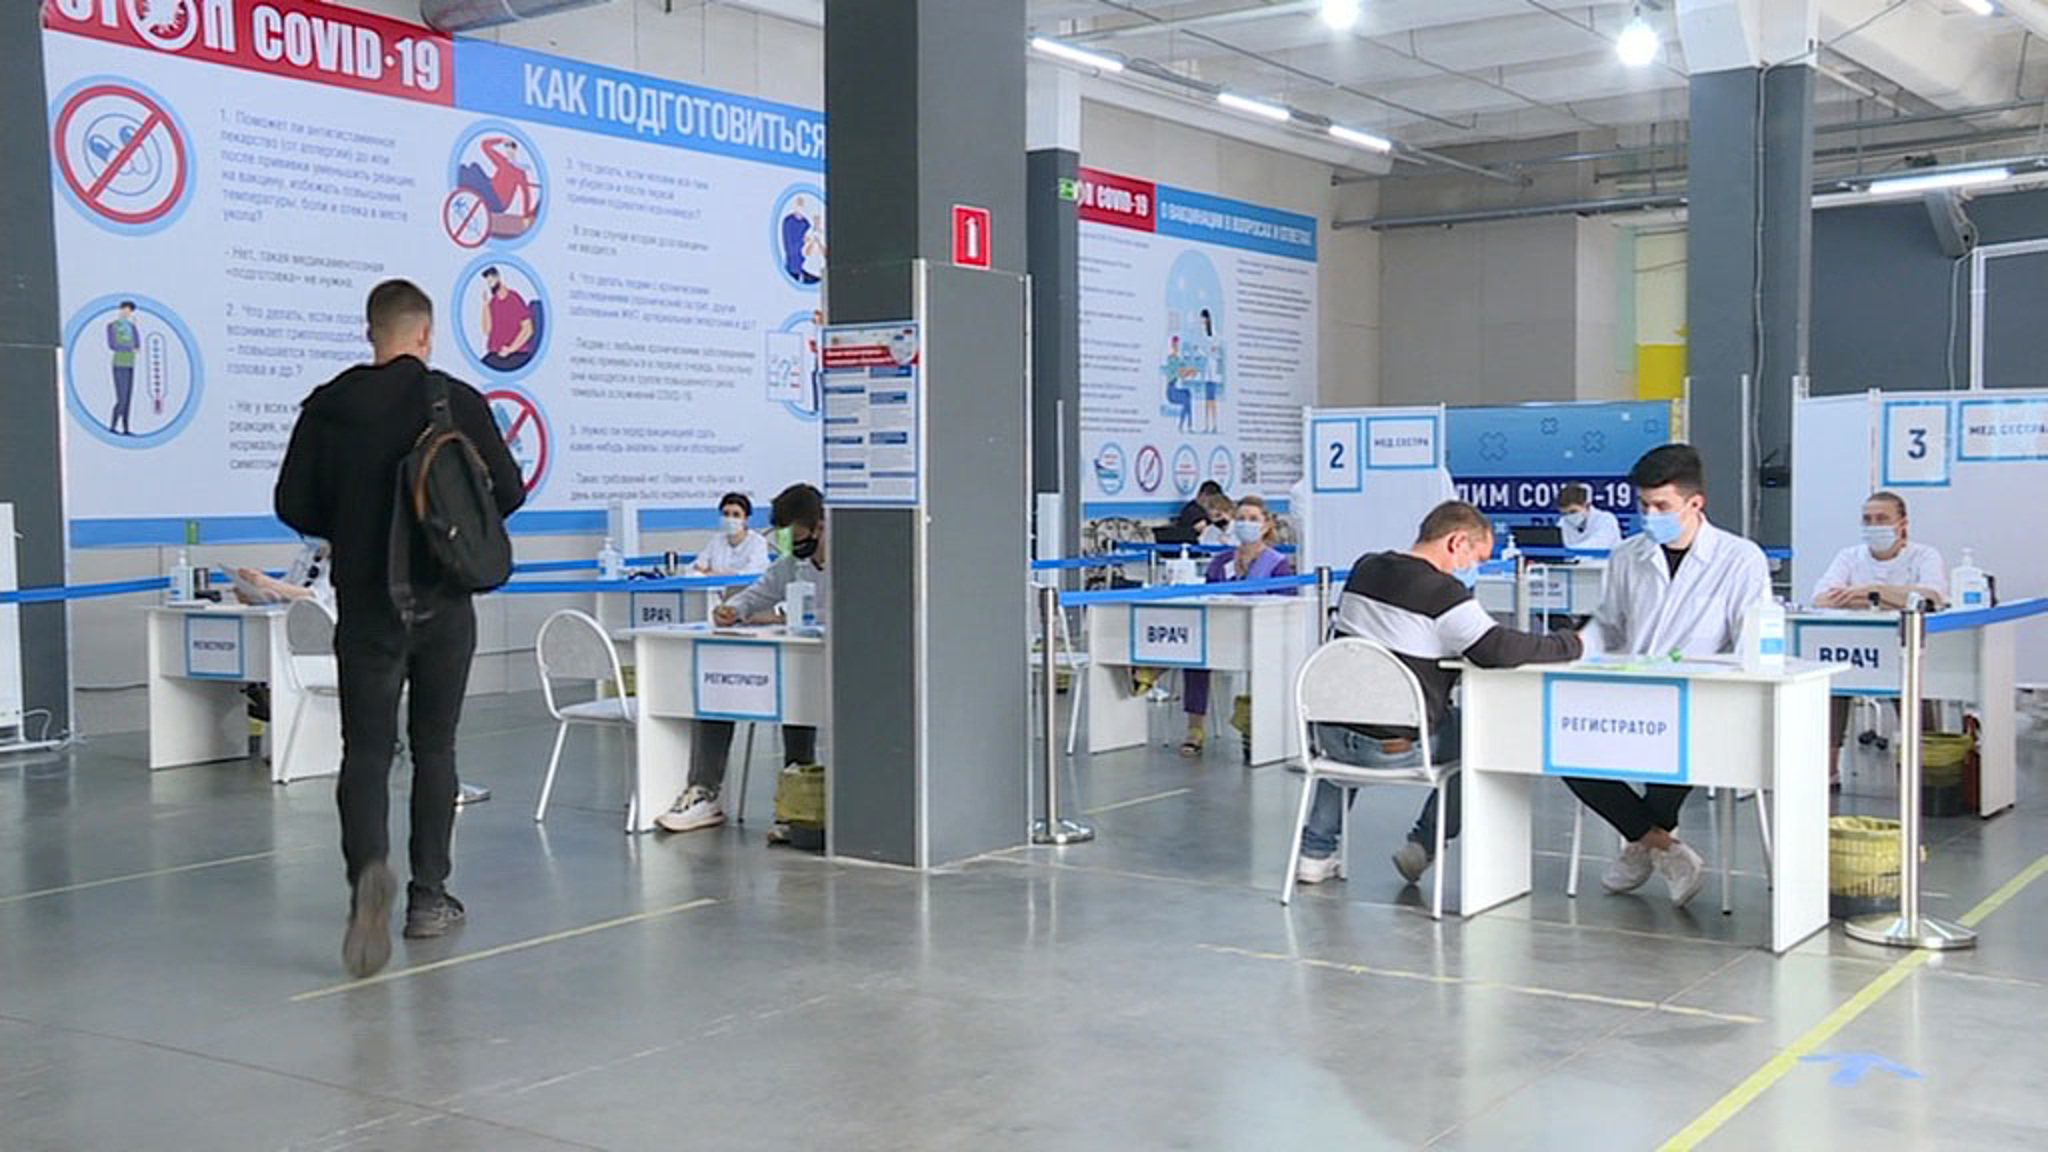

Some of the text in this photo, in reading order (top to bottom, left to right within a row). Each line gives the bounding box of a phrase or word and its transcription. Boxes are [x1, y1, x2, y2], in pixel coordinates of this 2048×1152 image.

[523, 63, 826, 161] КАК ПОДГОТОВИТЬСЯ
[1906, 428, 1928, 459] 3
[1329, 443, 1345, 468] 2
[1147, 625, 1189, 643] ВРАЧ
[703, 671, 769, 688] РЕГИСТРАТОР
[1560, 716, 1668, 737] РЕГИСТРАТОР
